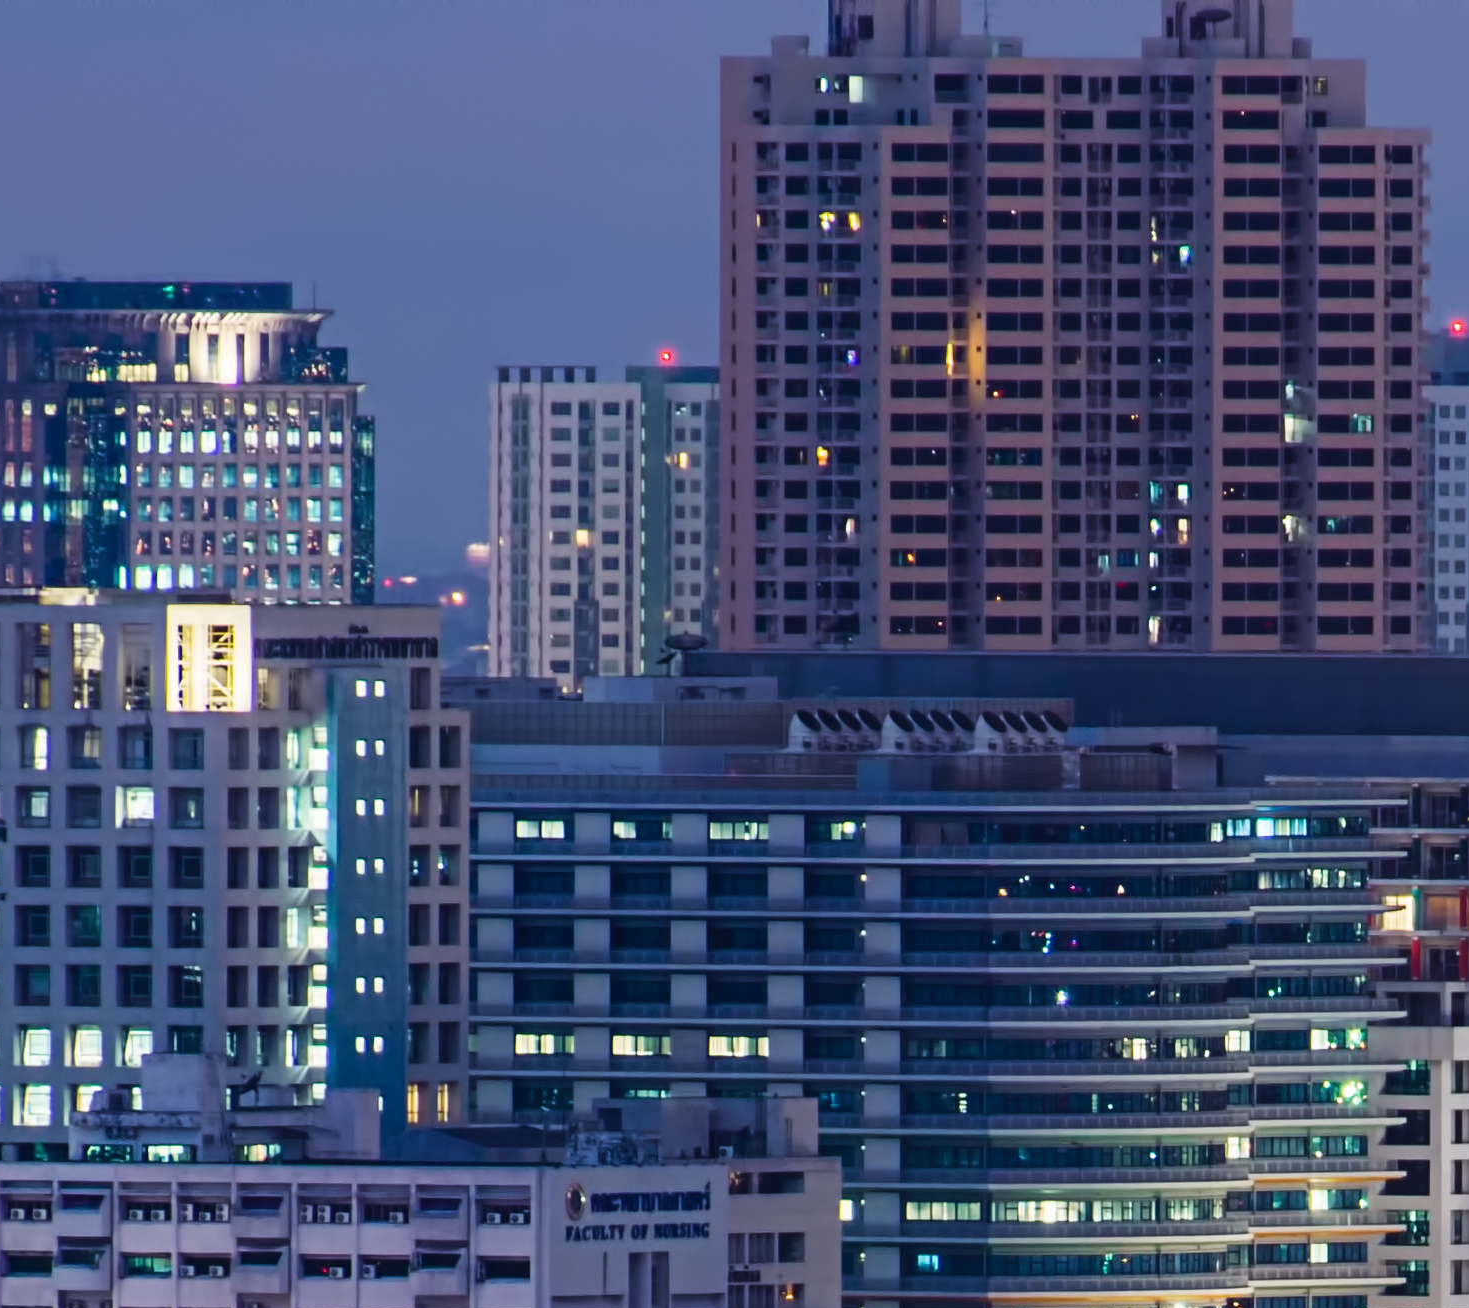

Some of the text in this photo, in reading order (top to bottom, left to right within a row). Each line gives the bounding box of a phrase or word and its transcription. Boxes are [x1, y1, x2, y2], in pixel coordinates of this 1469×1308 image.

[565, 1222, 710, 1241] FACULTY OF NURSING
